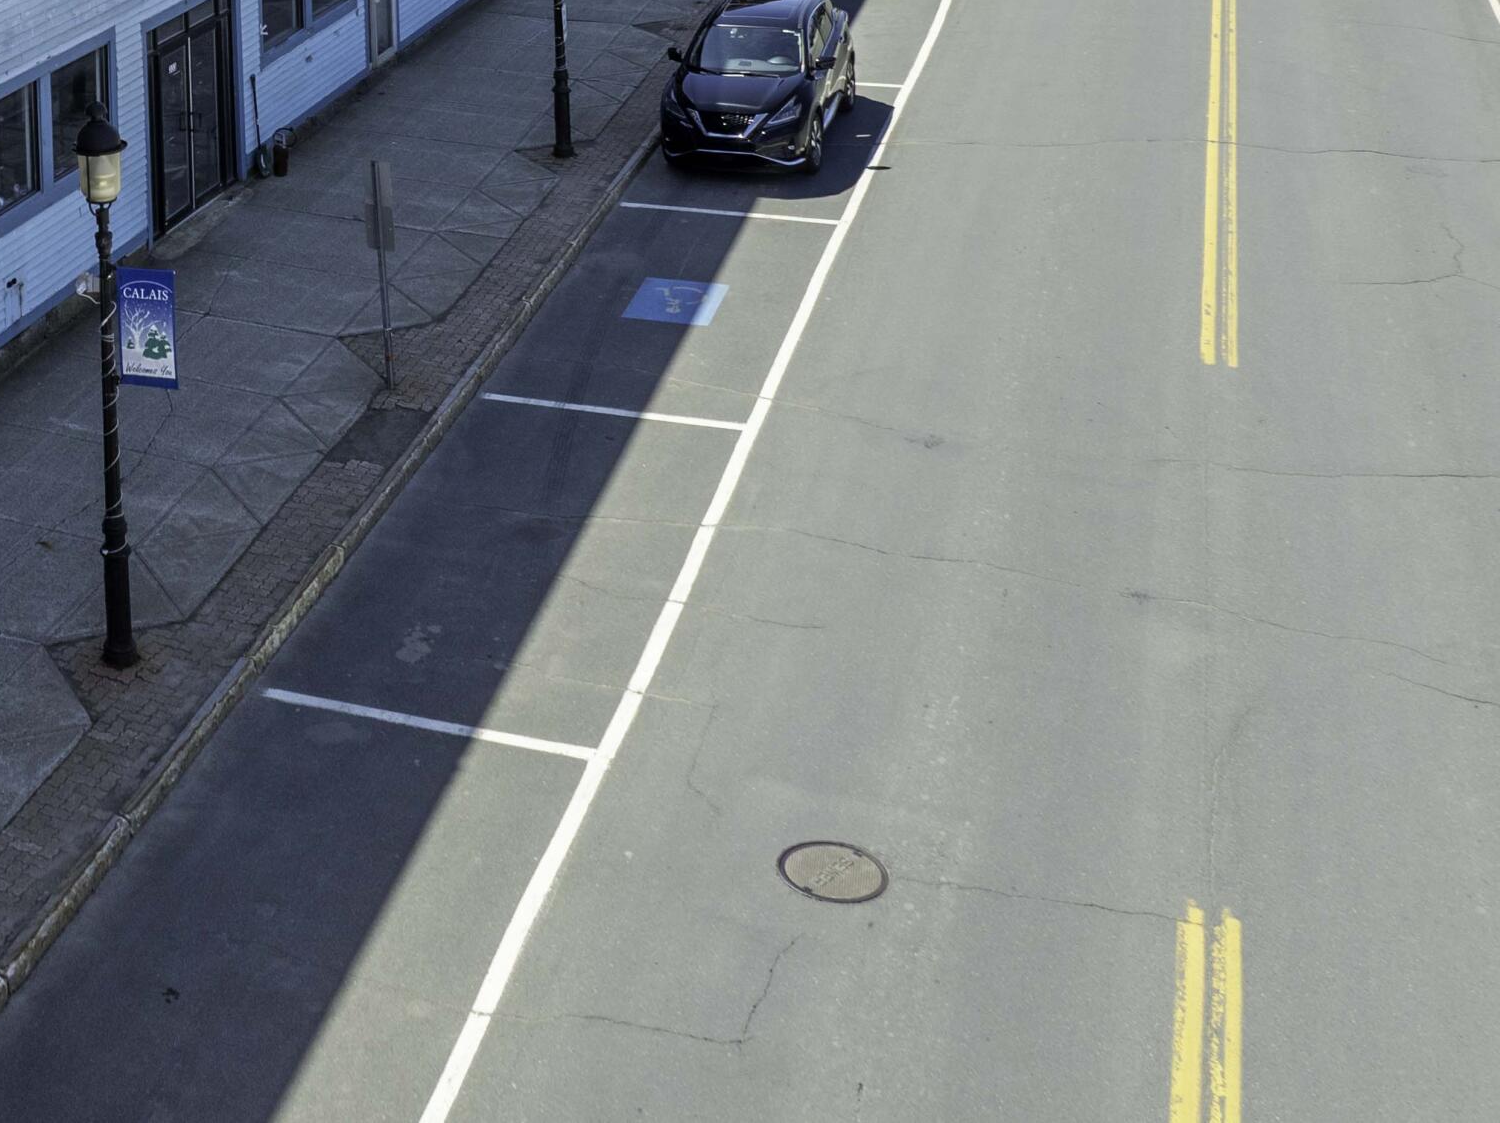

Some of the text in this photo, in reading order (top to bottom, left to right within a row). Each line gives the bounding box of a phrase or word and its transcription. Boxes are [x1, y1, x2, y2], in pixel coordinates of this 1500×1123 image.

[122, 287, 169, 302] CALAIS
[125, 362, 173, 376] Welcomes You
